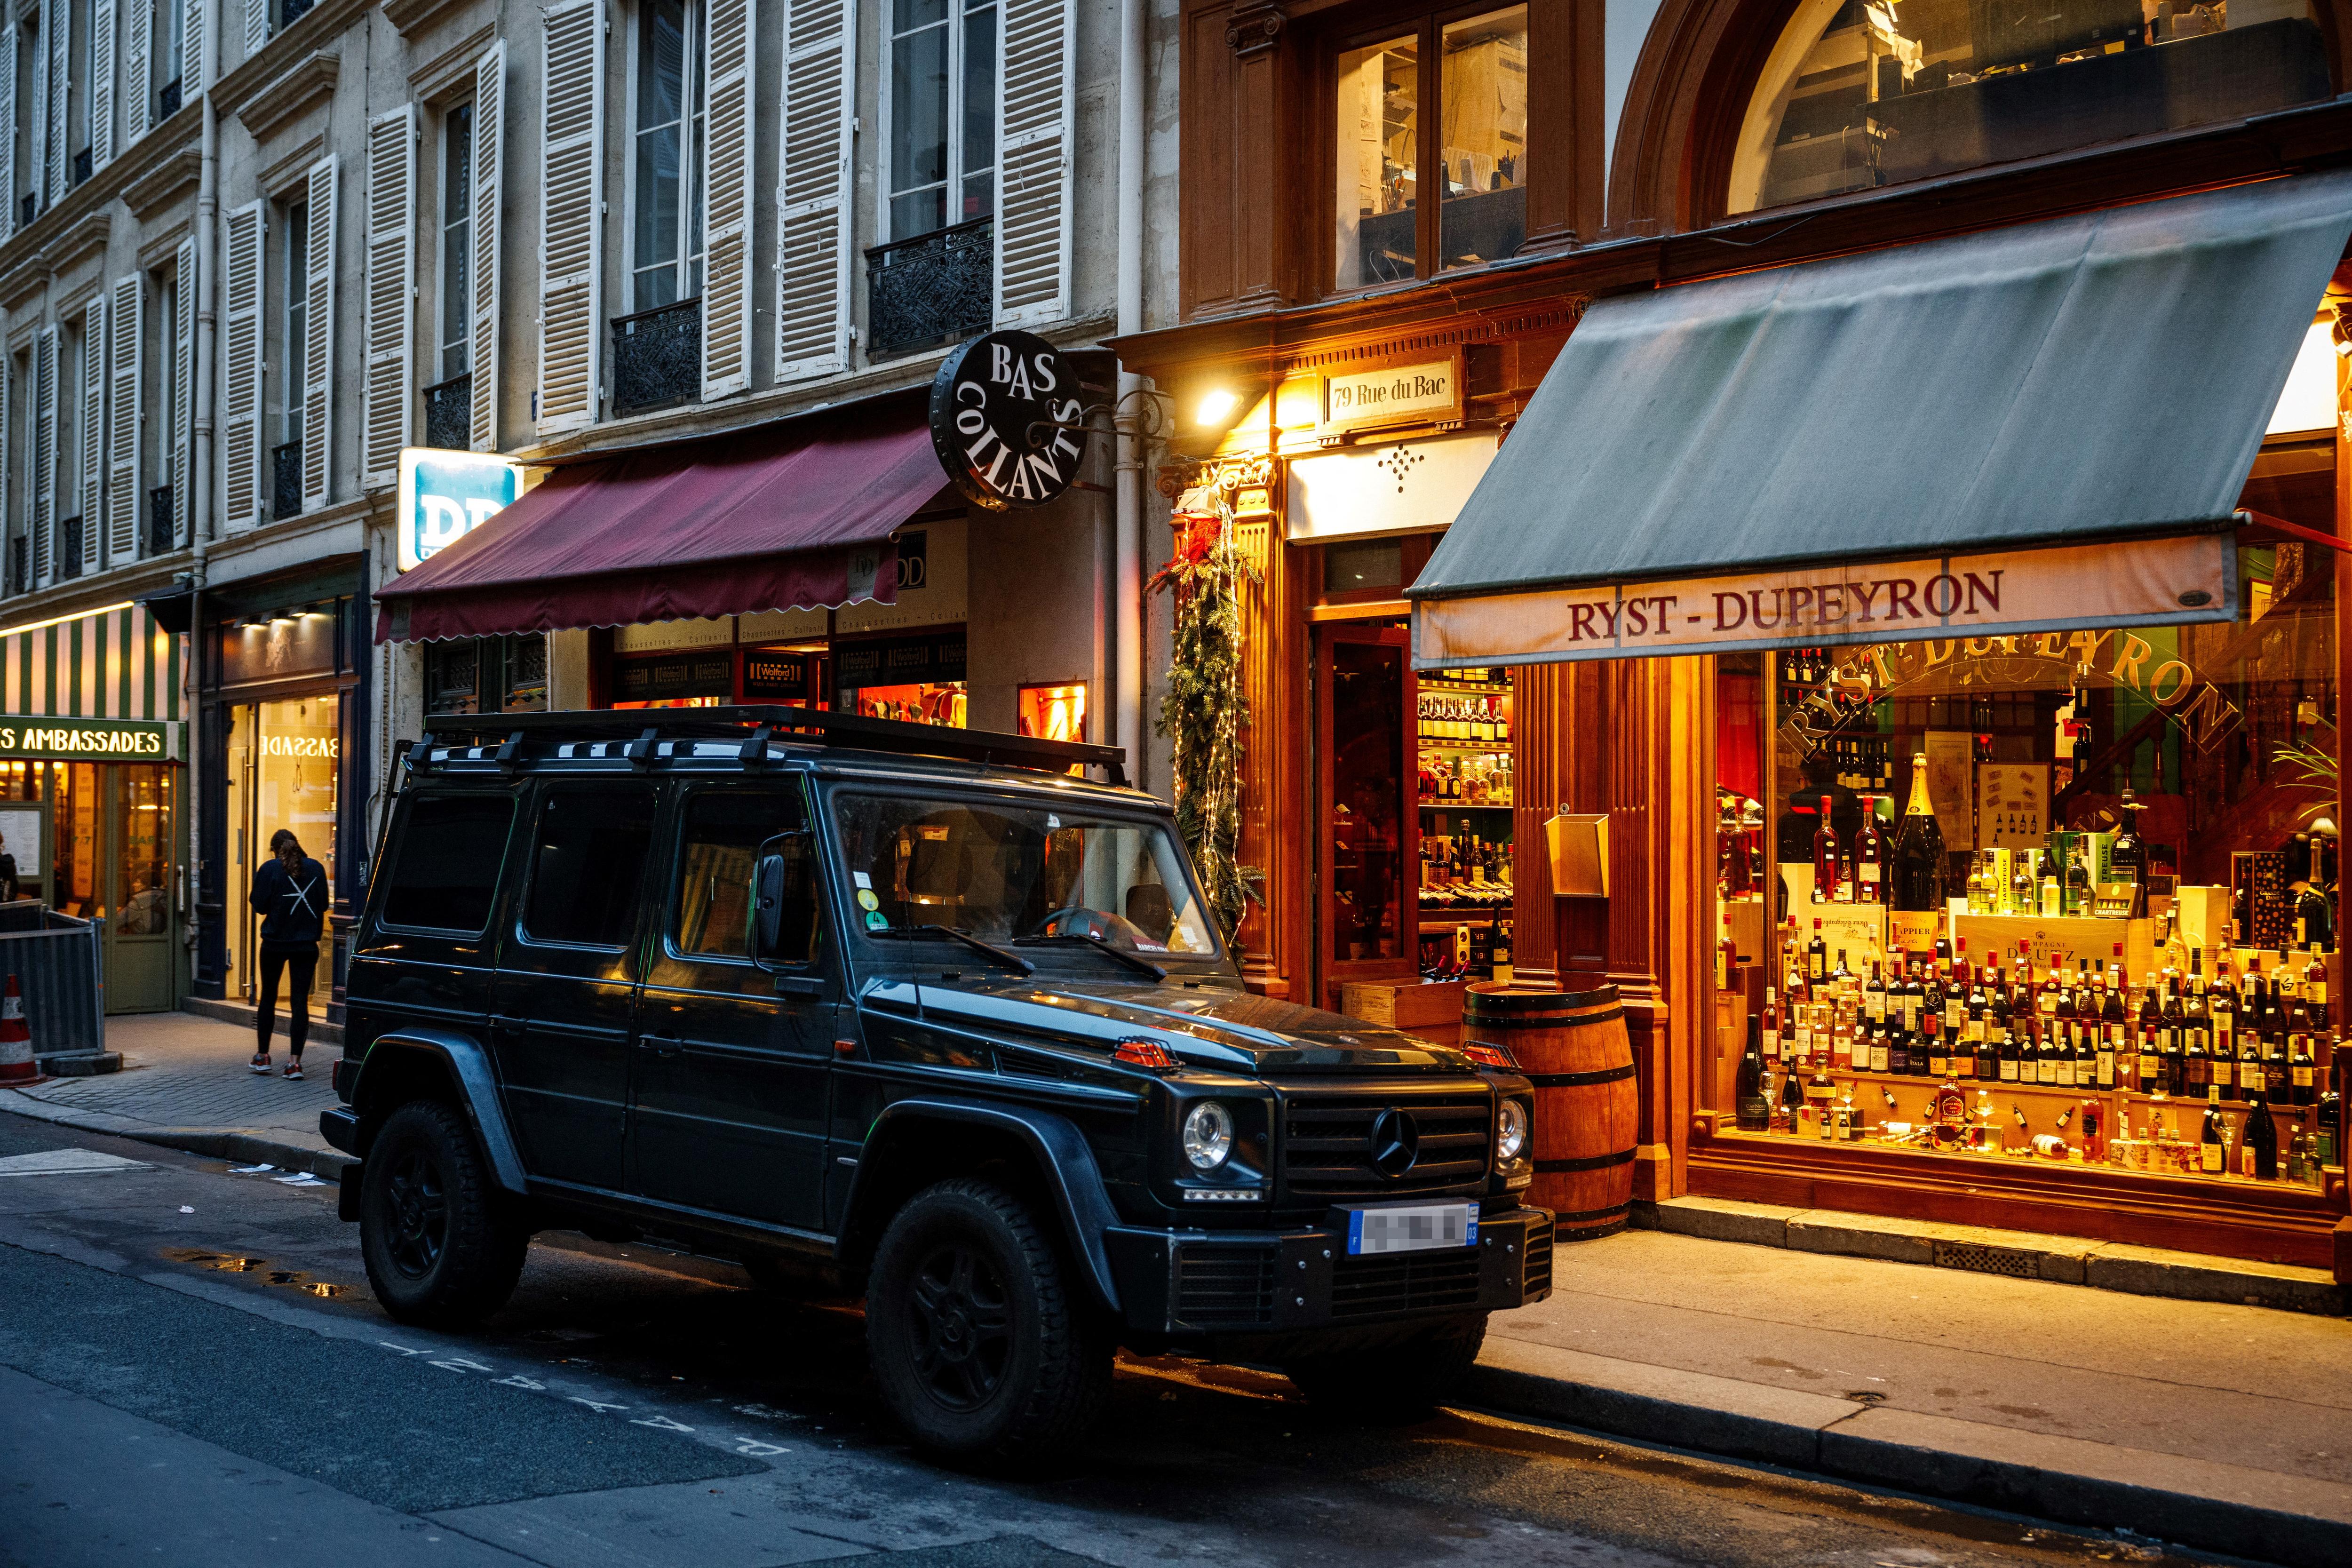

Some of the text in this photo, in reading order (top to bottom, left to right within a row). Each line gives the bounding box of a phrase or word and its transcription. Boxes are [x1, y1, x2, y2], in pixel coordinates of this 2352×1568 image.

[990, 342, 1057, 400] BAS
[1334, 376, 1445, 408] 79 Rue du Bac
[957, 382, 1082, 500] COLLANTS
[1568, 596, 1677, 642] RYST
[1711, 570, 2004, 632] DUPEYRON
[742, 629, 785, 639] Chaussettes
[794, 625, 824, 634] Collants
[843, 617, 907, 629] Chaussettes
[761, 667, 790, 677] Wolford
[23, 728, 160, 753] AMBASSADES
[2281, 978, 2294, 991] 白
[1353, 1227, 1477, 1245] F 03
